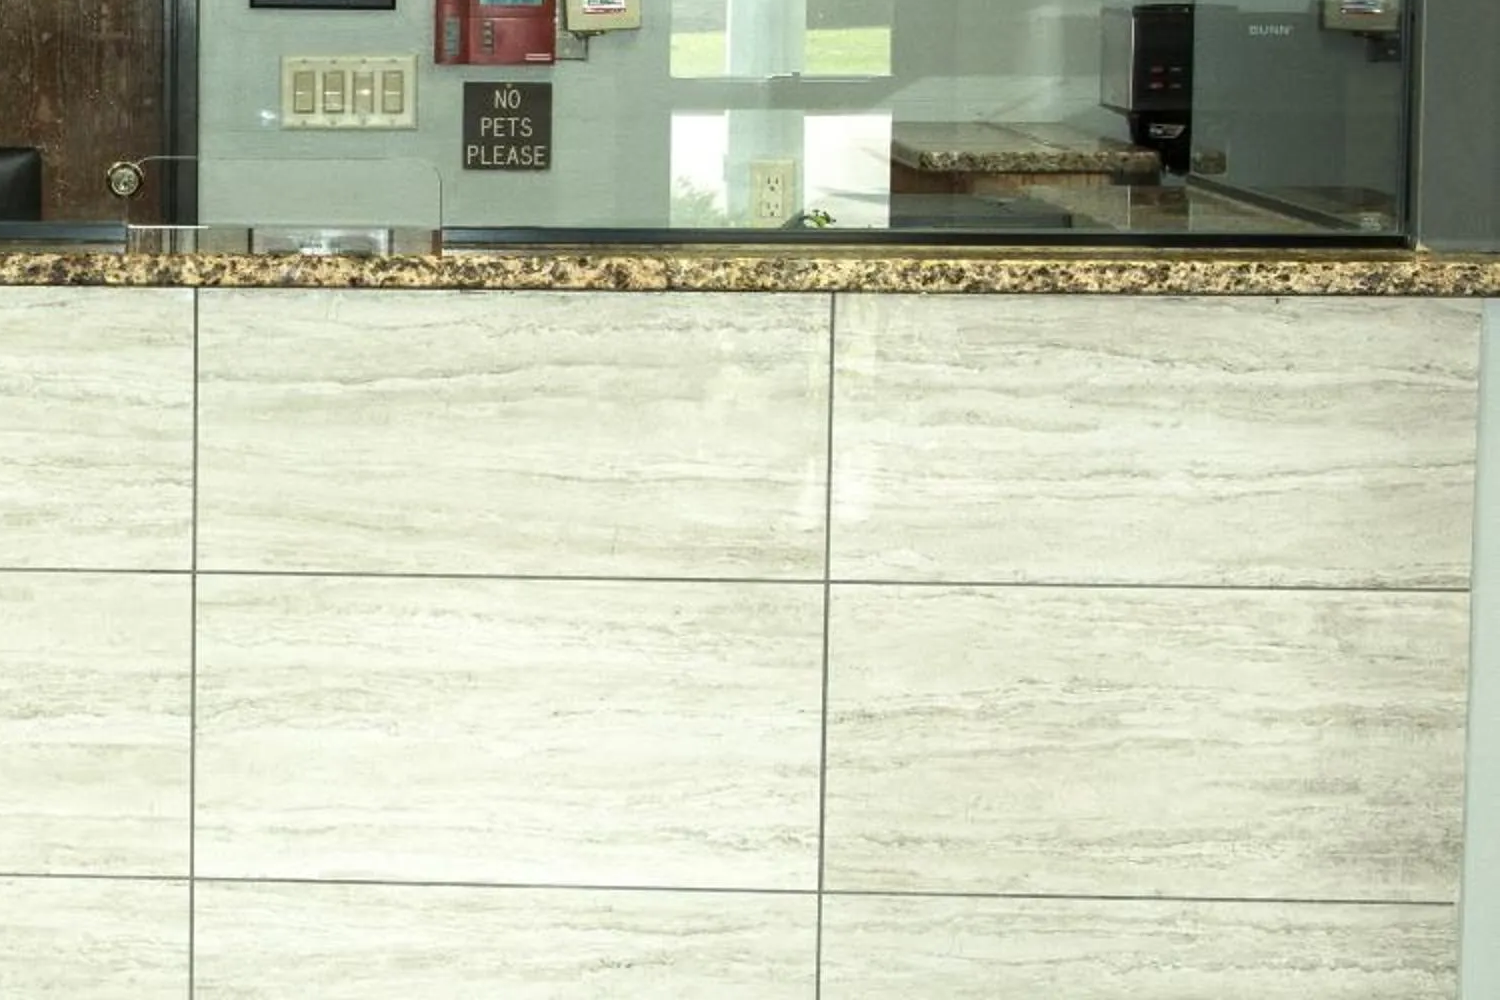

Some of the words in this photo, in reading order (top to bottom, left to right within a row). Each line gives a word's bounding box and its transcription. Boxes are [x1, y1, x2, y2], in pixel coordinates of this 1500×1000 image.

[494, 89, 521, 109] NO
[480, 117, 533, 137] PETS
[467, 145, 545, 166] PLEASE
